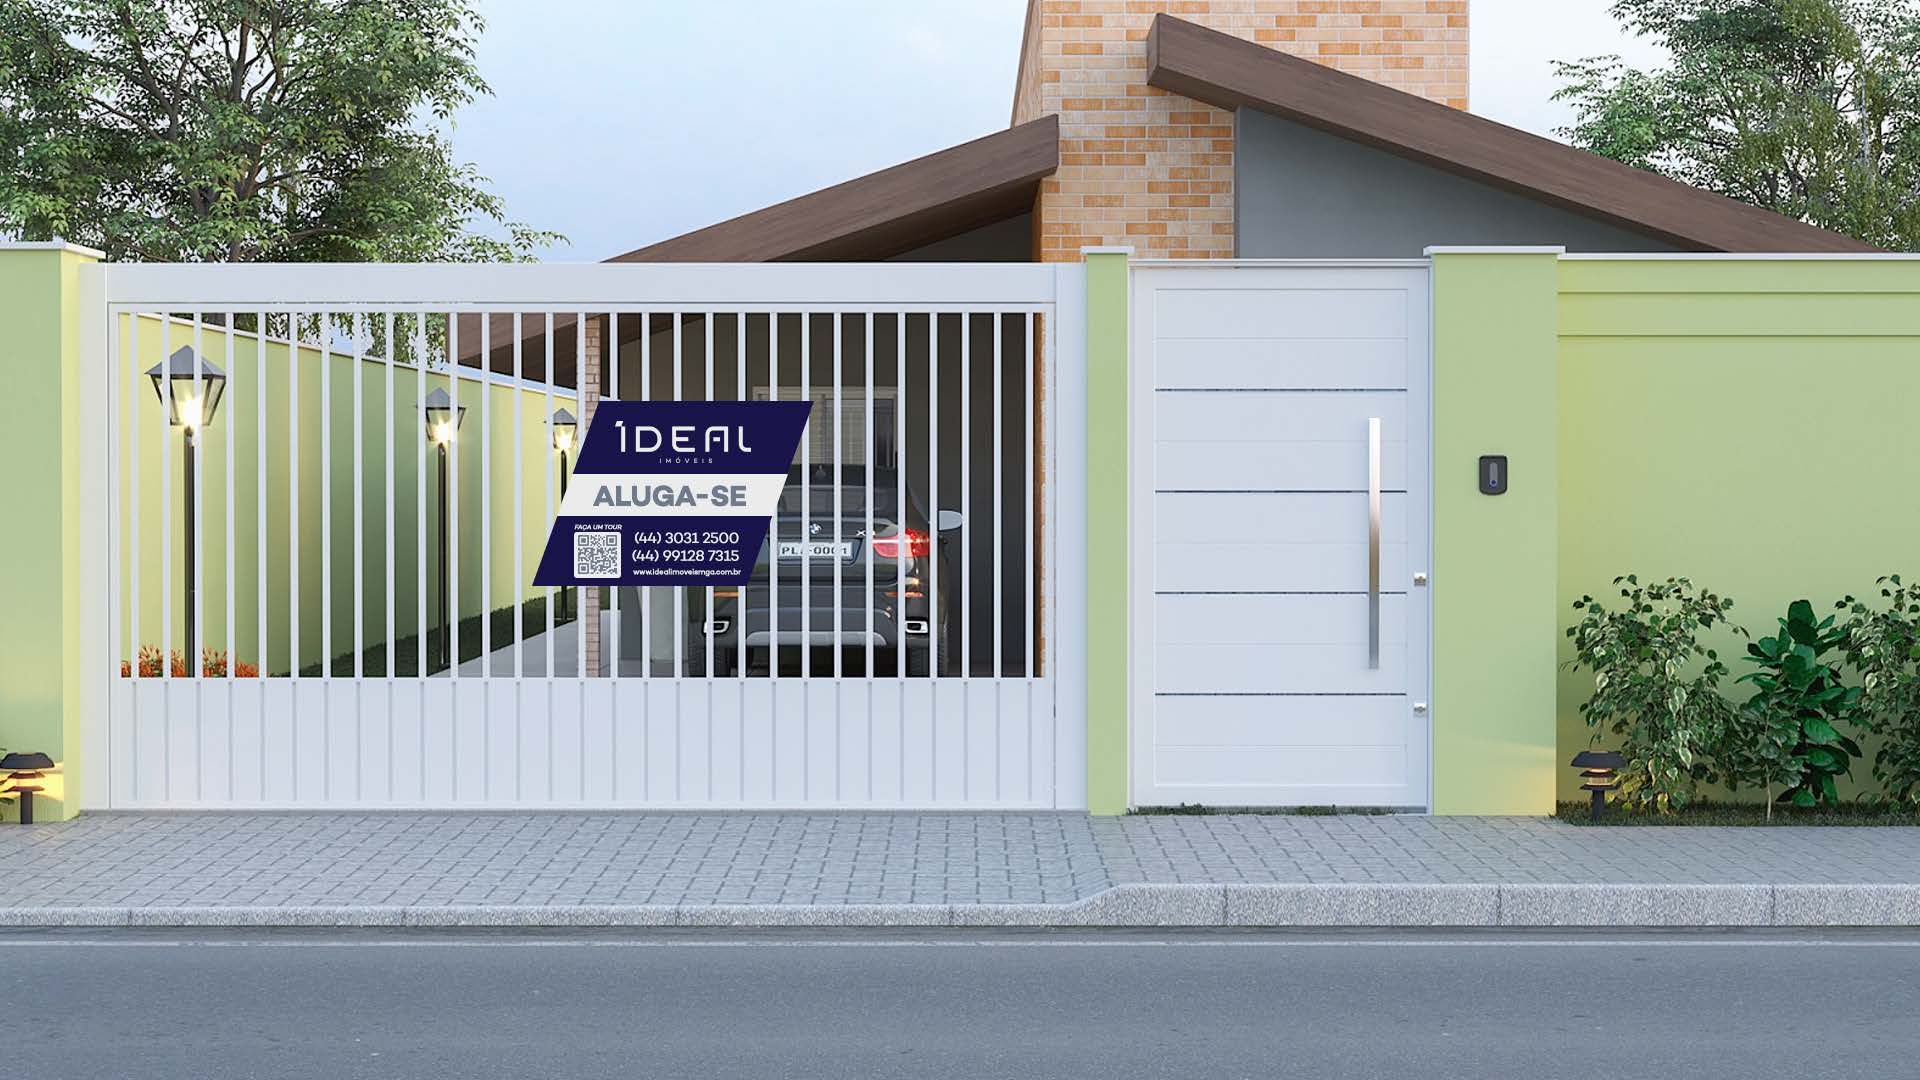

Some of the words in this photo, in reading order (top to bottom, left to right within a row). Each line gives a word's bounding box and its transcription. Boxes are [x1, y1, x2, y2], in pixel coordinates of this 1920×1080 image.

[614, 420, 752, 453] IDEAL
[658, 456, 713, 464] IMÓVEIS
[592, 485, 747, 507] ALUGA-SE
[574, 523, 592, 532] FAÇA
[592, 523, 604, 531] UM
[604, 523, 623, 531] TOUR
[634, 531, 662, 544] (44)
[664, 531, 699, 544] 3031
[702, 531, 740, 544] 2500
[631, 549, 659, 562] (44)
[662, 549, 705, 561] 99128
[707, 549, 740, 562] 7315
[632, 567, 742, 576] www.idealimoveismga.com.br
